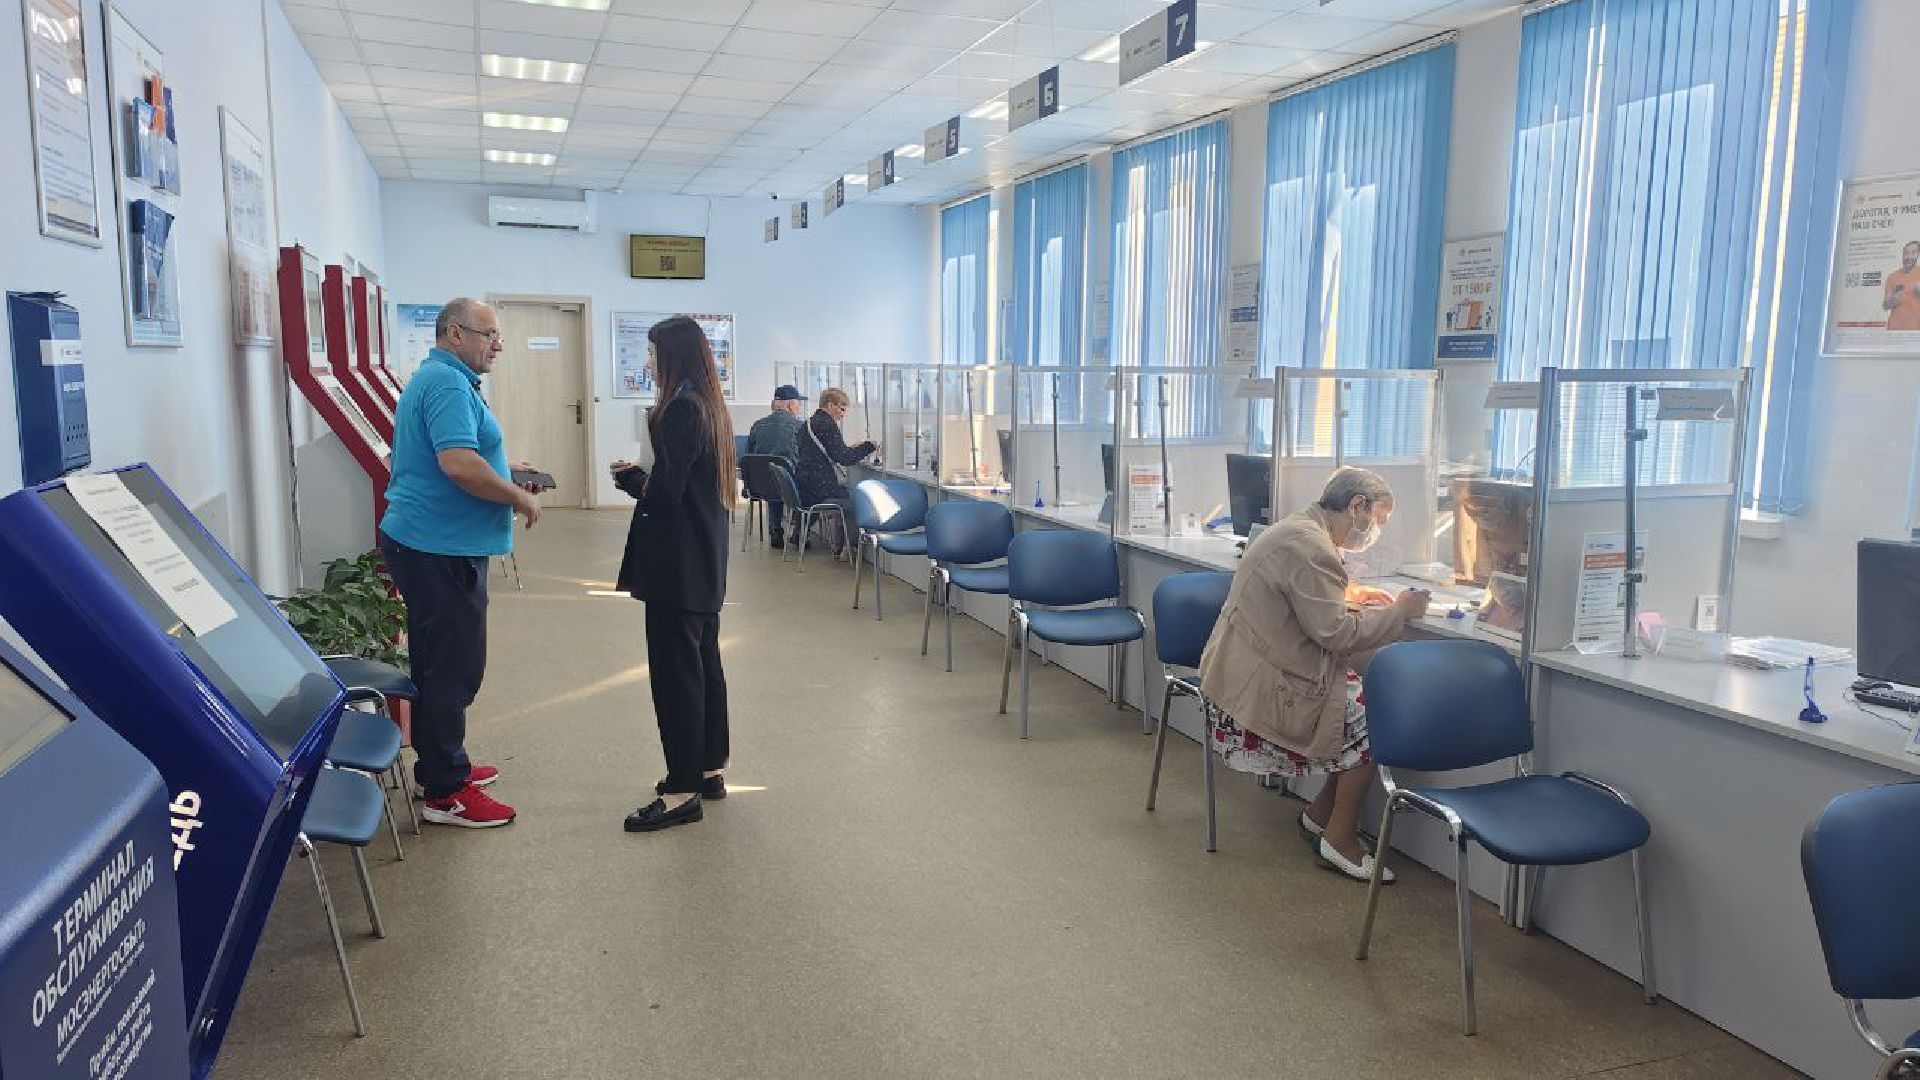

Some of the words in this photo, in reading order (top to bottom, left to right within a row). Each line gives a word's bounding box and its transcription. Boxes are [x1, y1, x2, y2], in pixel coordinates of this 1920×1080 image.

[1175, 13, 1189, 47] 7
[1044, 81, 1054, 107] 6
[948, 128, 958, 148] 5
[52, 839, 136, 956] ТЕРМИНАЛ
[32, 855, 155, 1028] ОБСЛУЖИВАНИЯ
